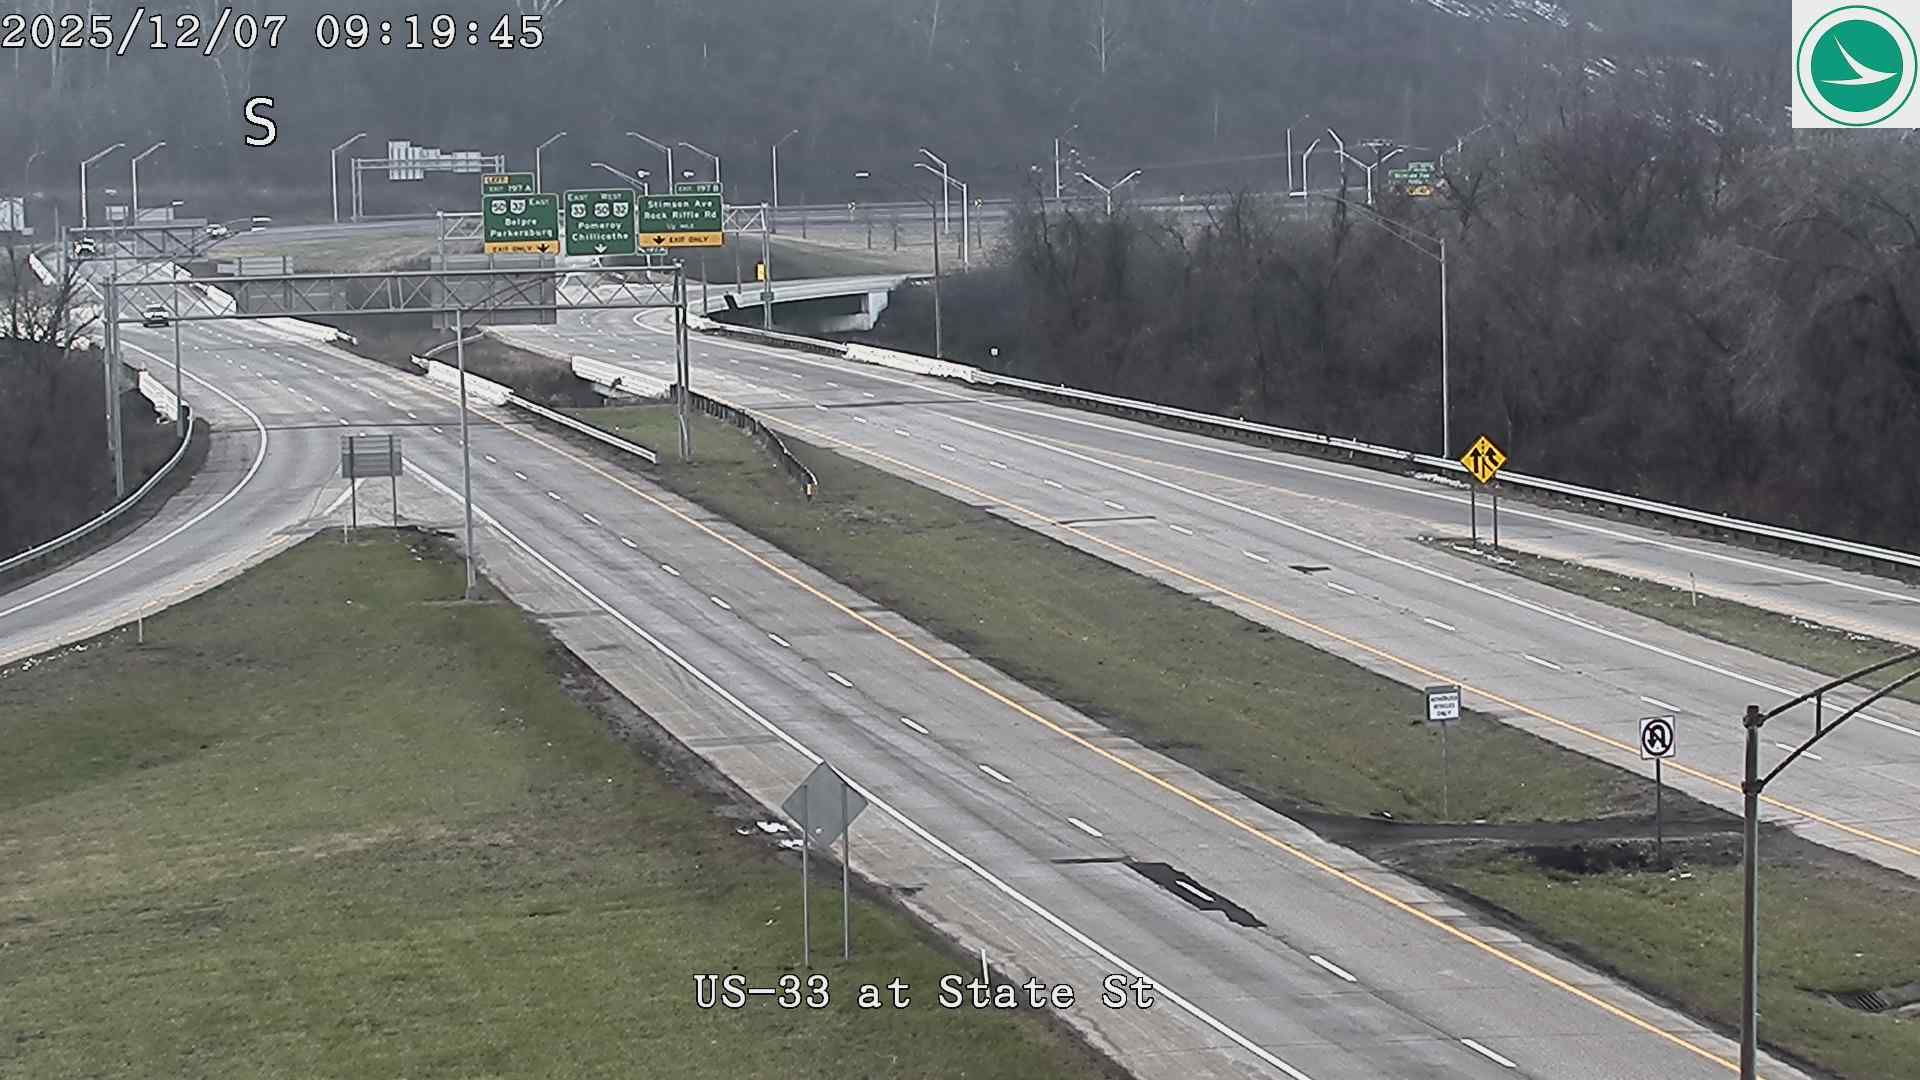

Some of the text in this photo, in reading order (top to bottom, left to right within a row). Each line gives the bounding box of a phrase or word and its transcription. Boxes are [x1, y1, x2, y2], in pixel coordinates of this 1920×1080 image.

[508, 184, 523, 192] 197
[528, 197, 549, 206] EAST
[568, 193, 589, 201] EAST
[647, 200, 713, 208] Stimson Ave
[644, 210, 717, 219] Rock Riffle Rd
[504, 218, 537, 227] Belpre
[578, 222, 622, 230] Pomeroy
[490, 229, 553, 238] Parkersburg
[571, 232, 629, 241] Chillicothe
